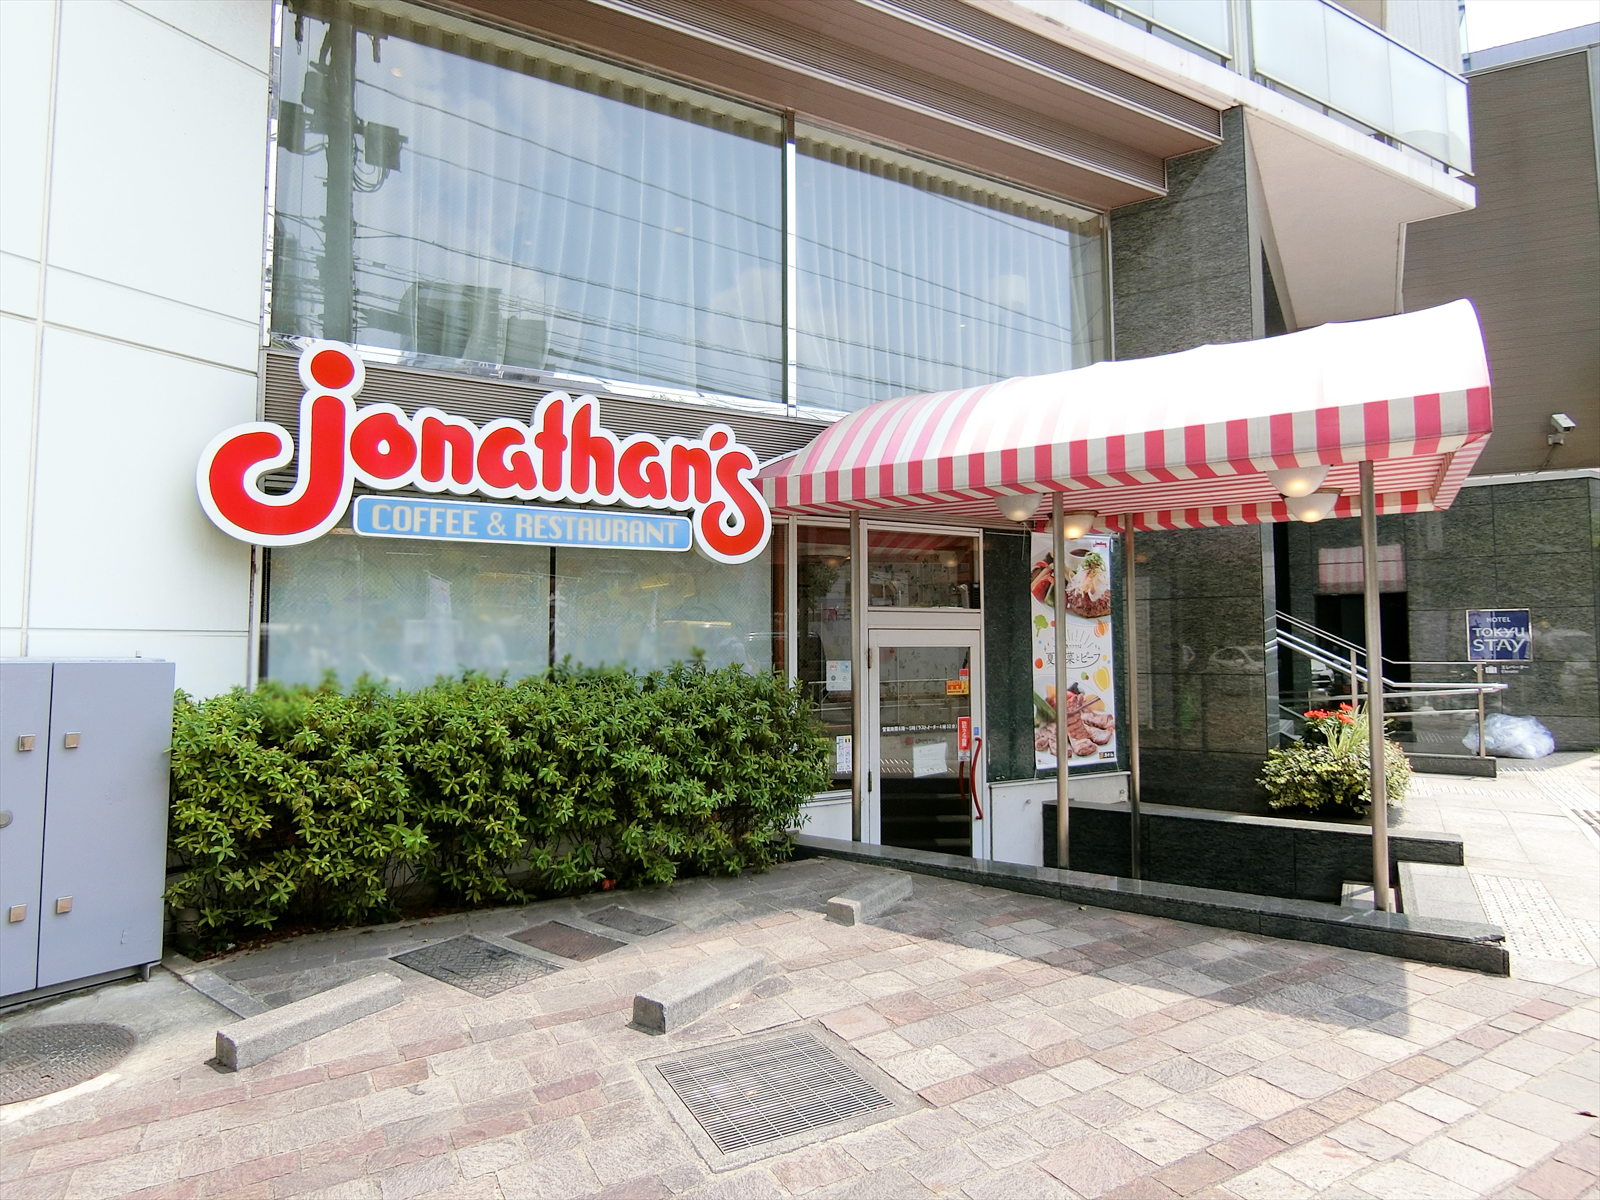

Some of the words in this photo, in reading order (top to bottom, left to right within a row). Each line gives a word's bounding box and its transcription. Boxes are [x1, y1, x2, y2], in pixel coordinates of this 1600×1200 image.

[372, 503, 478, 538] COFFEE
[486, 511, 508, 537] &
[515, 512, 679, 547] RESTAURANT
[1472, 627, 1525, 638] TOKYU
[1472, 638, 1526, 652] STAY
[1046, 652, 1101, 665] 夏菜とビーフ
